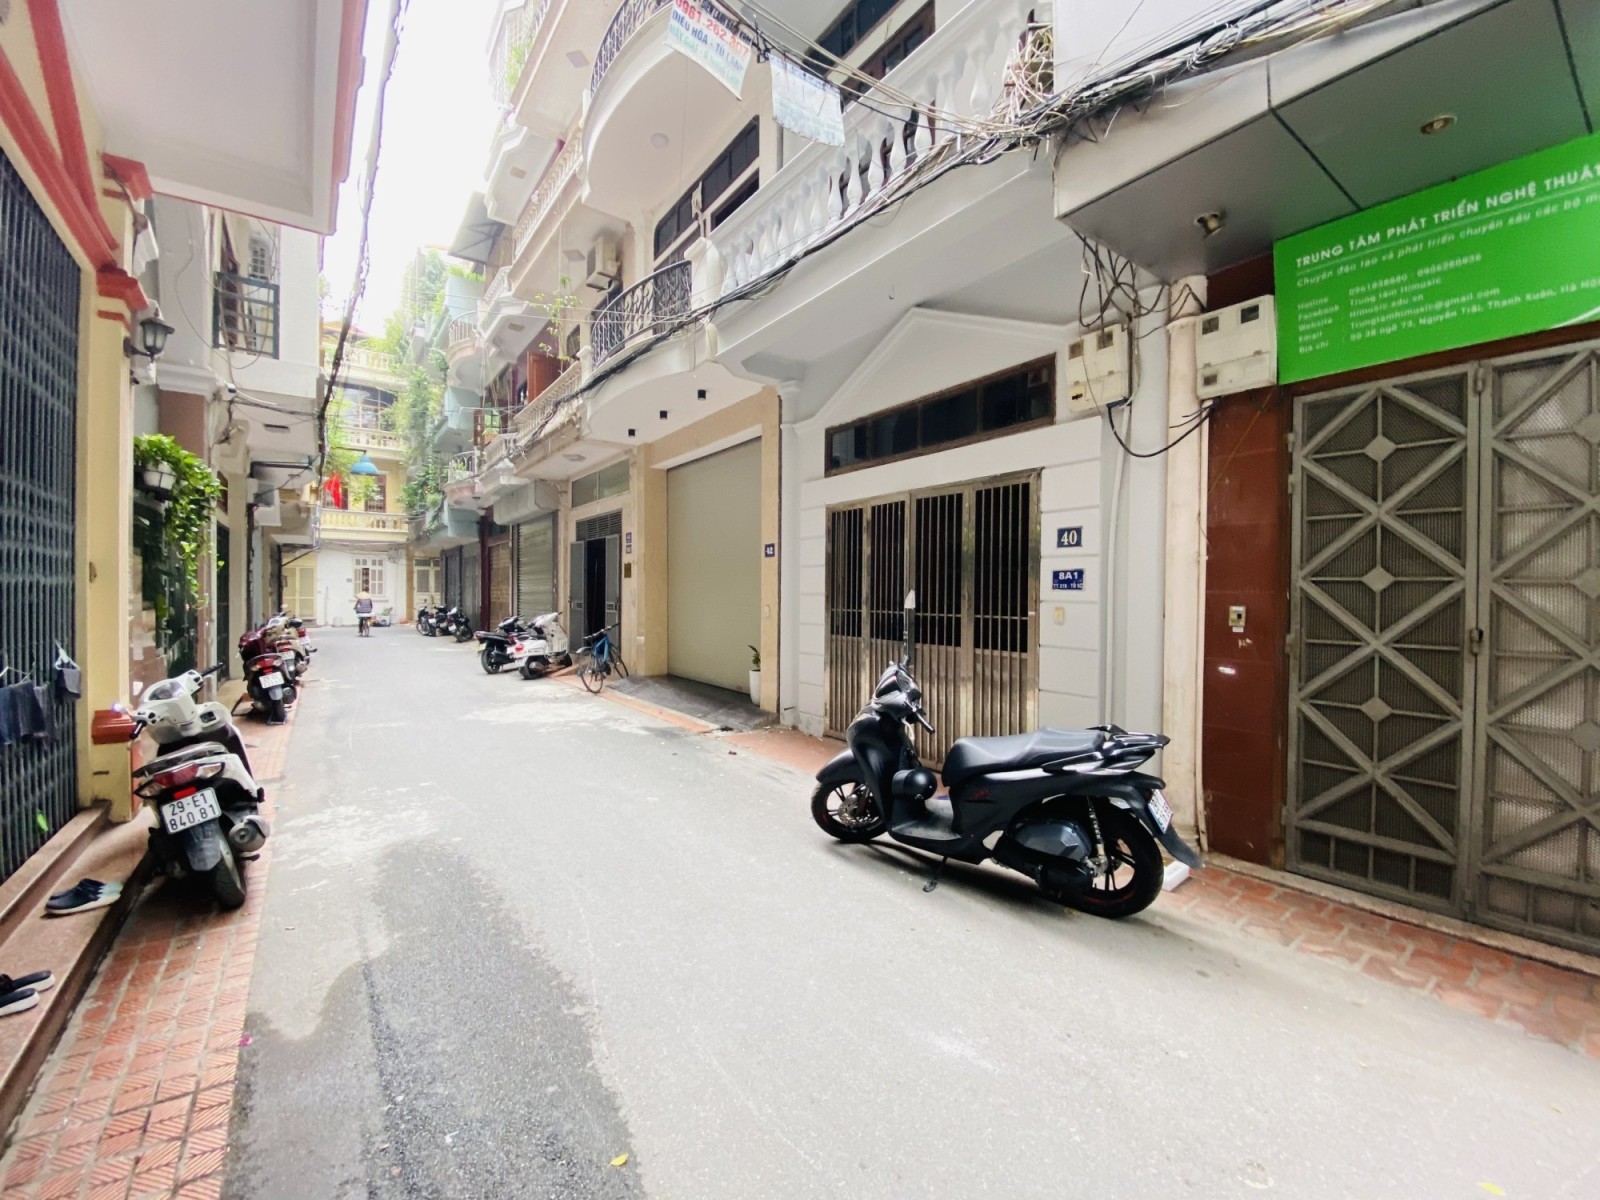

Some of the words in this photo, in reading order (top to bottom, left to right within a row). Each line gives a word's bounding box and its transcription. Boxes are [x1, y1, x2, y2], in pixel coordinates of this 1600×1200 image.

[1296, 245, 1343, 268] TRUNG
[1349, 231, 1381, 251] TÂM
[1387, 216, 1428, 240] PHÁT
[1433, 198, 1479, 224] TRIỂN
[1486, 180, 1537, 209] NGHỆ
[1061, 530, 1077, 546] 40
[169, 793, 208, 816] 29-E1
[169, 804, 216, 831] 840.81
